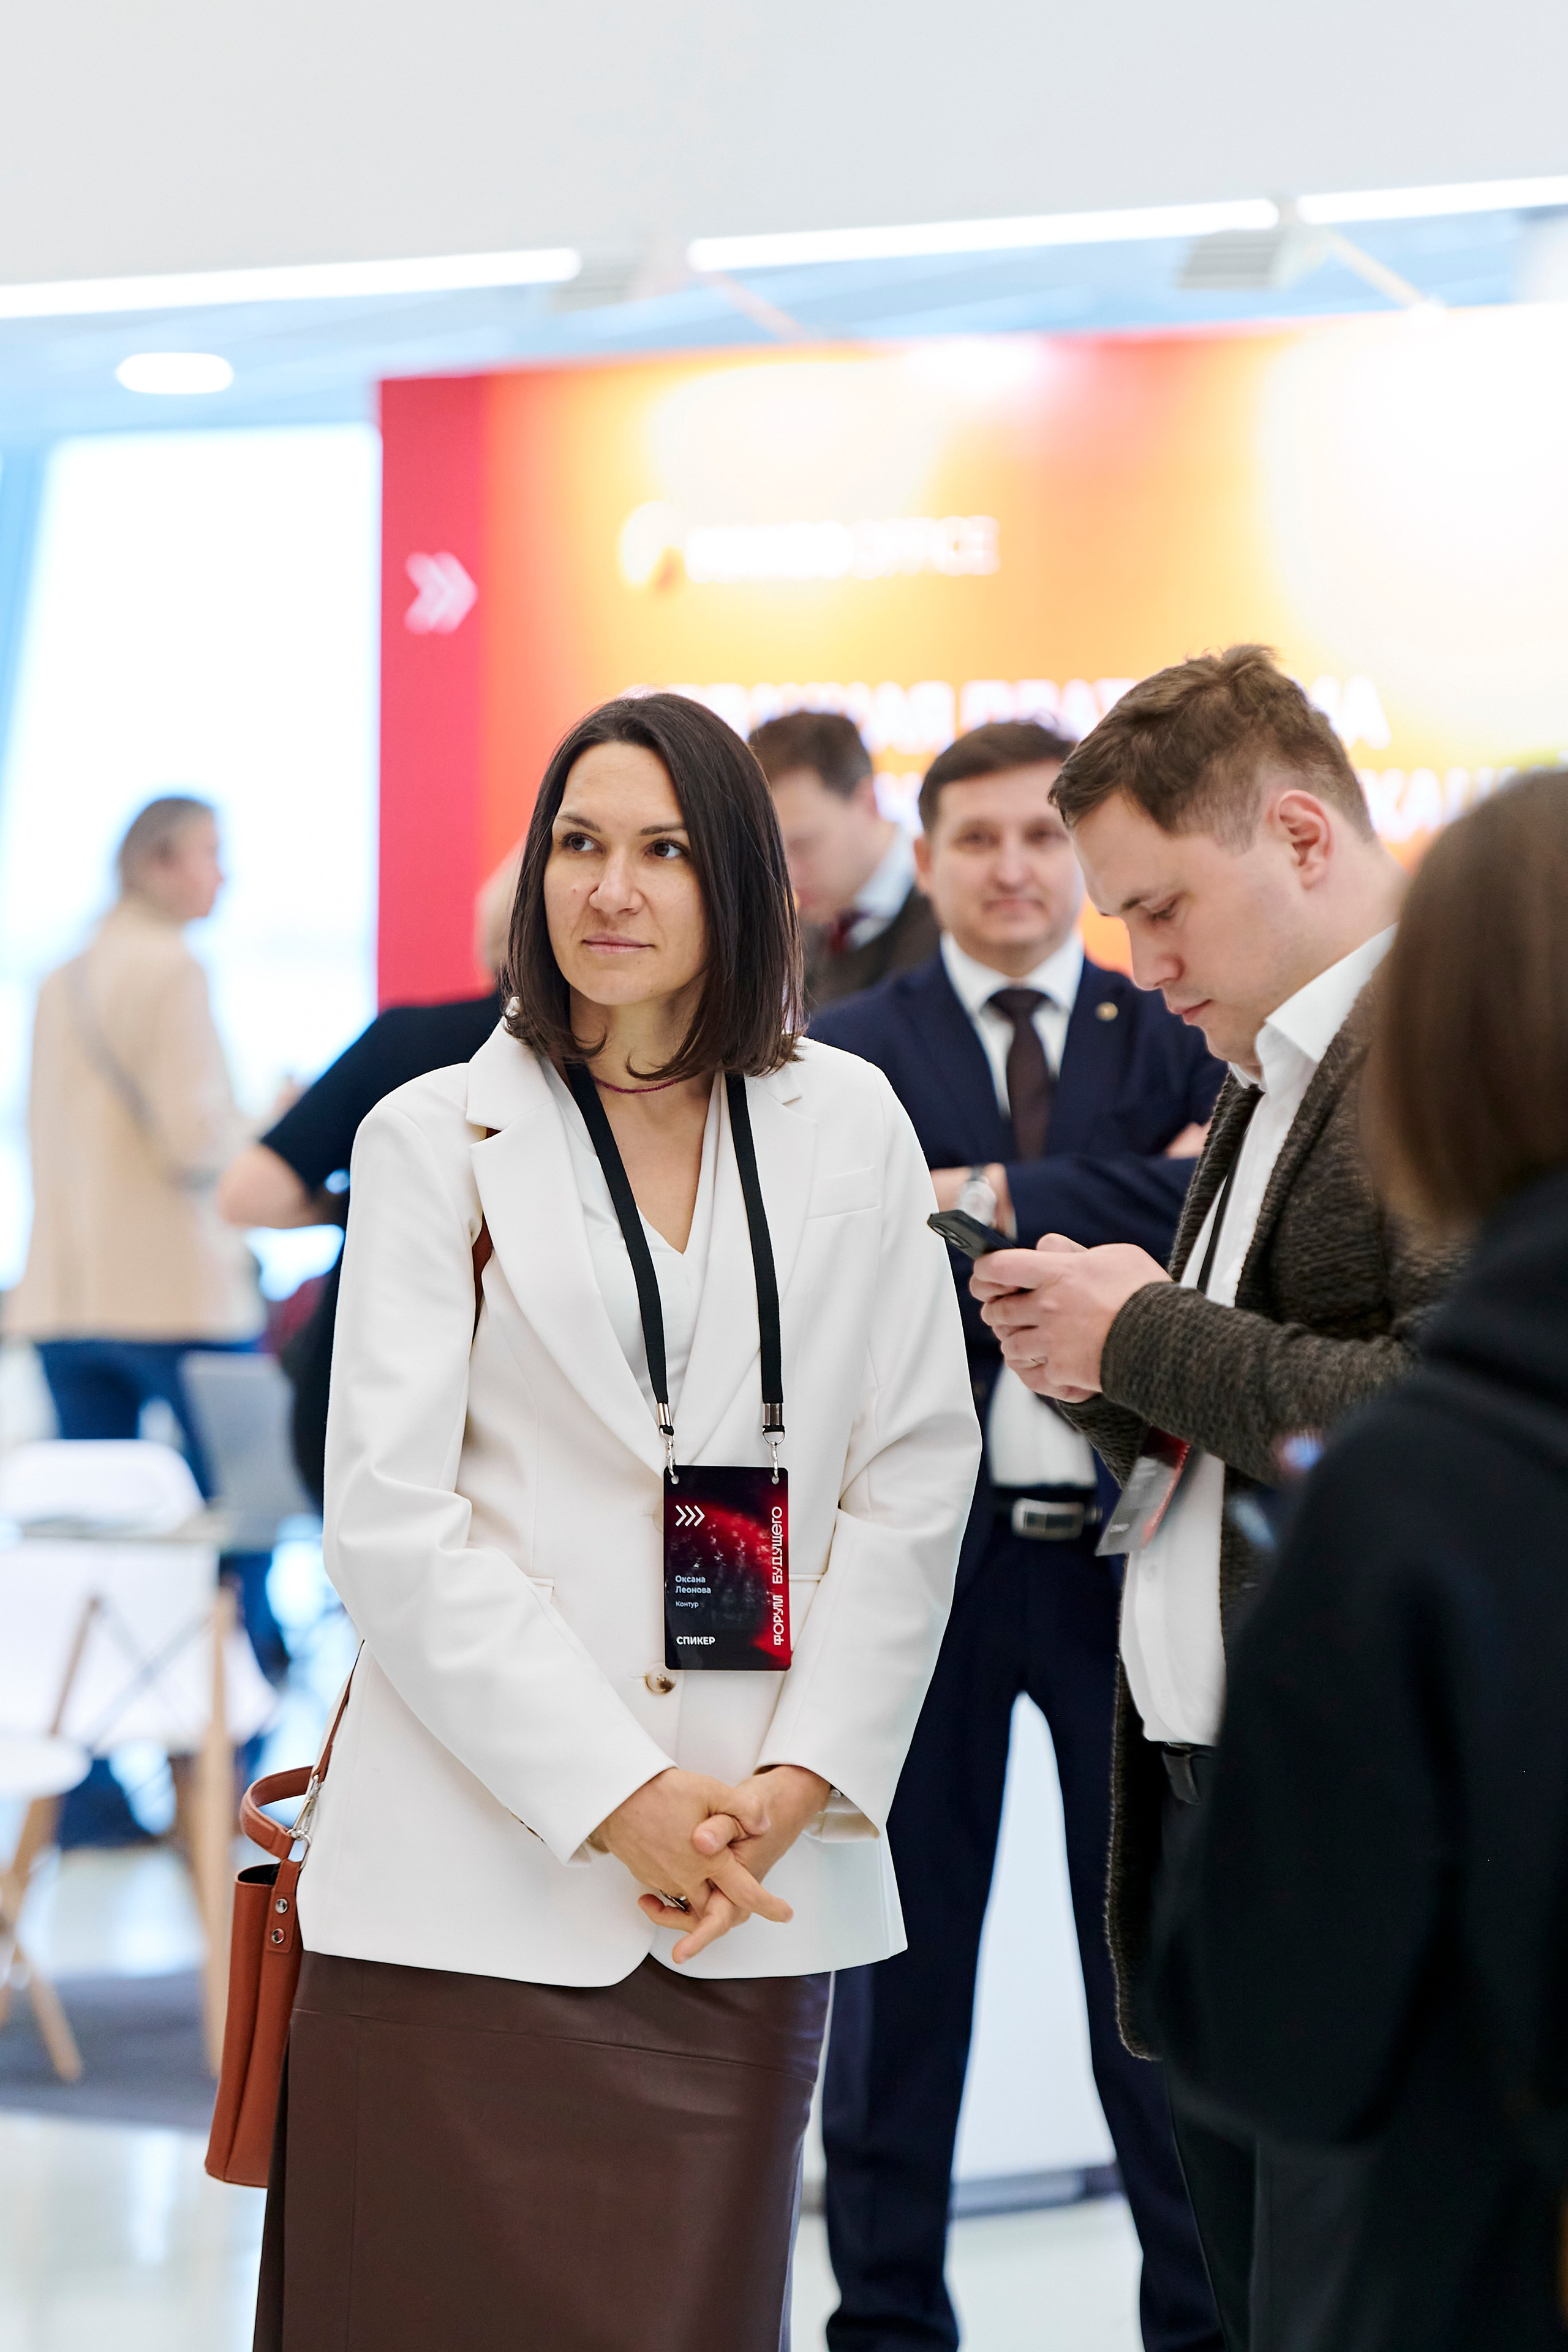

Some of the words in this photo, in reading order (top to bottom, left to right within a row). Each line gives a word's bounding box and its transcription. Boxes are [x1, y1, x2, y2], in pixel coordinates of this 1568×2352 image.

[675, 1575, 706, 1583] Оксана
[675, 1586, 711, 1594] Леонова
[772, 1594, 784, 1646] ФОРУМ
[676, 1636, 715, 1645] СПИКЕР
